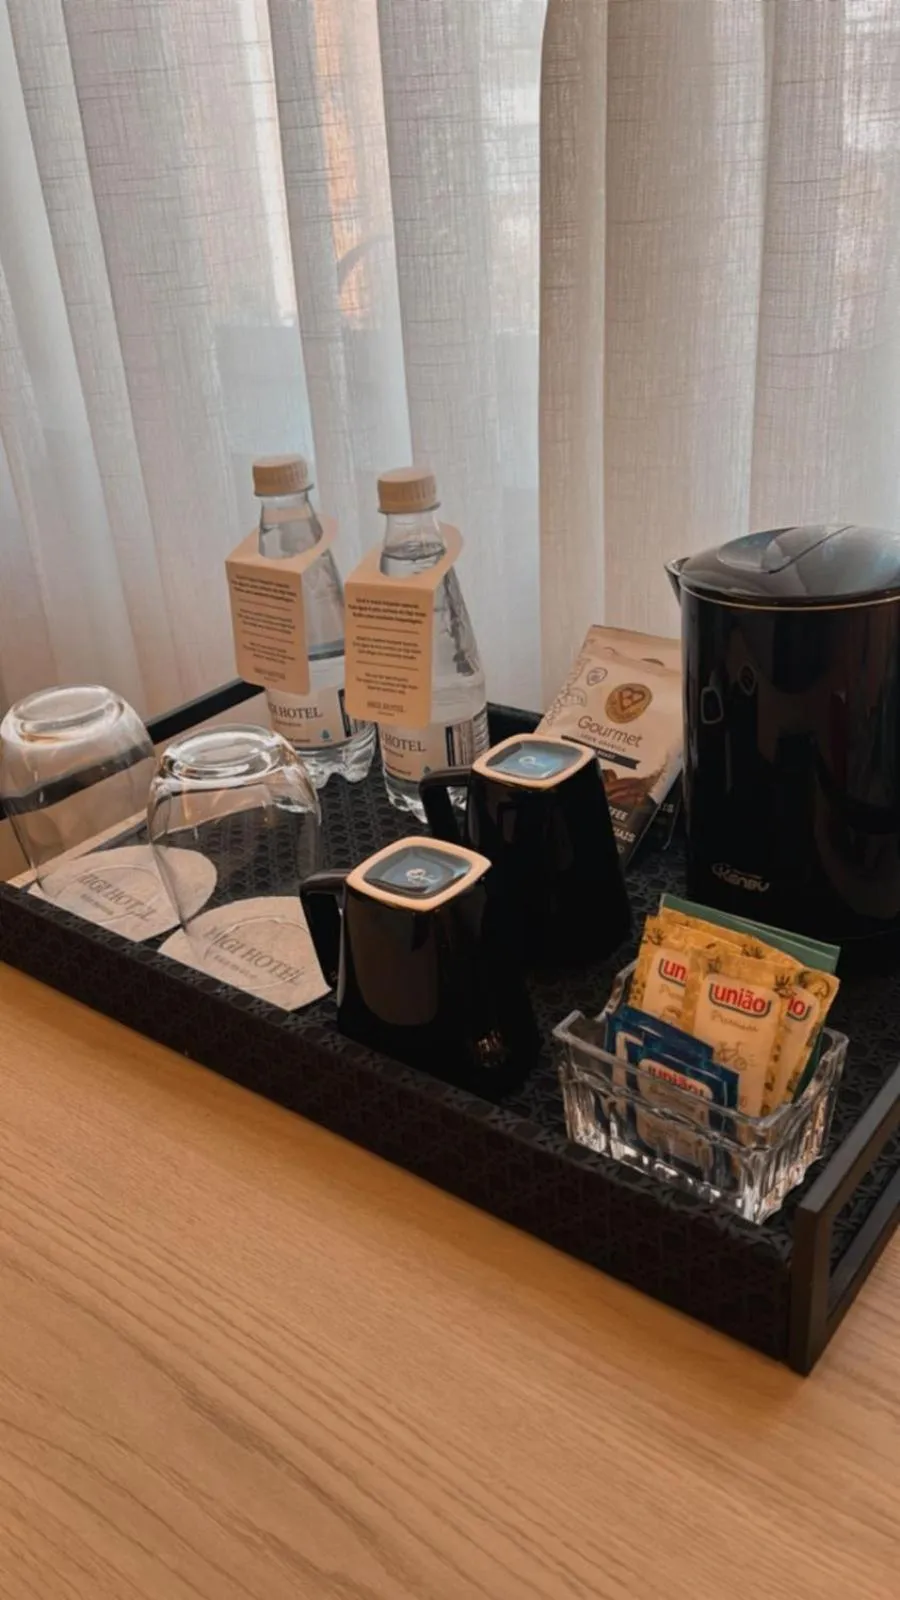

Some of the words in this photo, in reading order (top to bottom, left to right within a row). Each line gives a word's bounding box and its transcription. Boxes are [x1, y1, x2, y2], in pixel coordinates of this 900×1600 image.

[279, 706, 322, 719] HOTEL
[577, 715, 643, 748] Gourmet
[241, 947, 305, 985] HOTEL
[714, 982, 767, 1014] união
